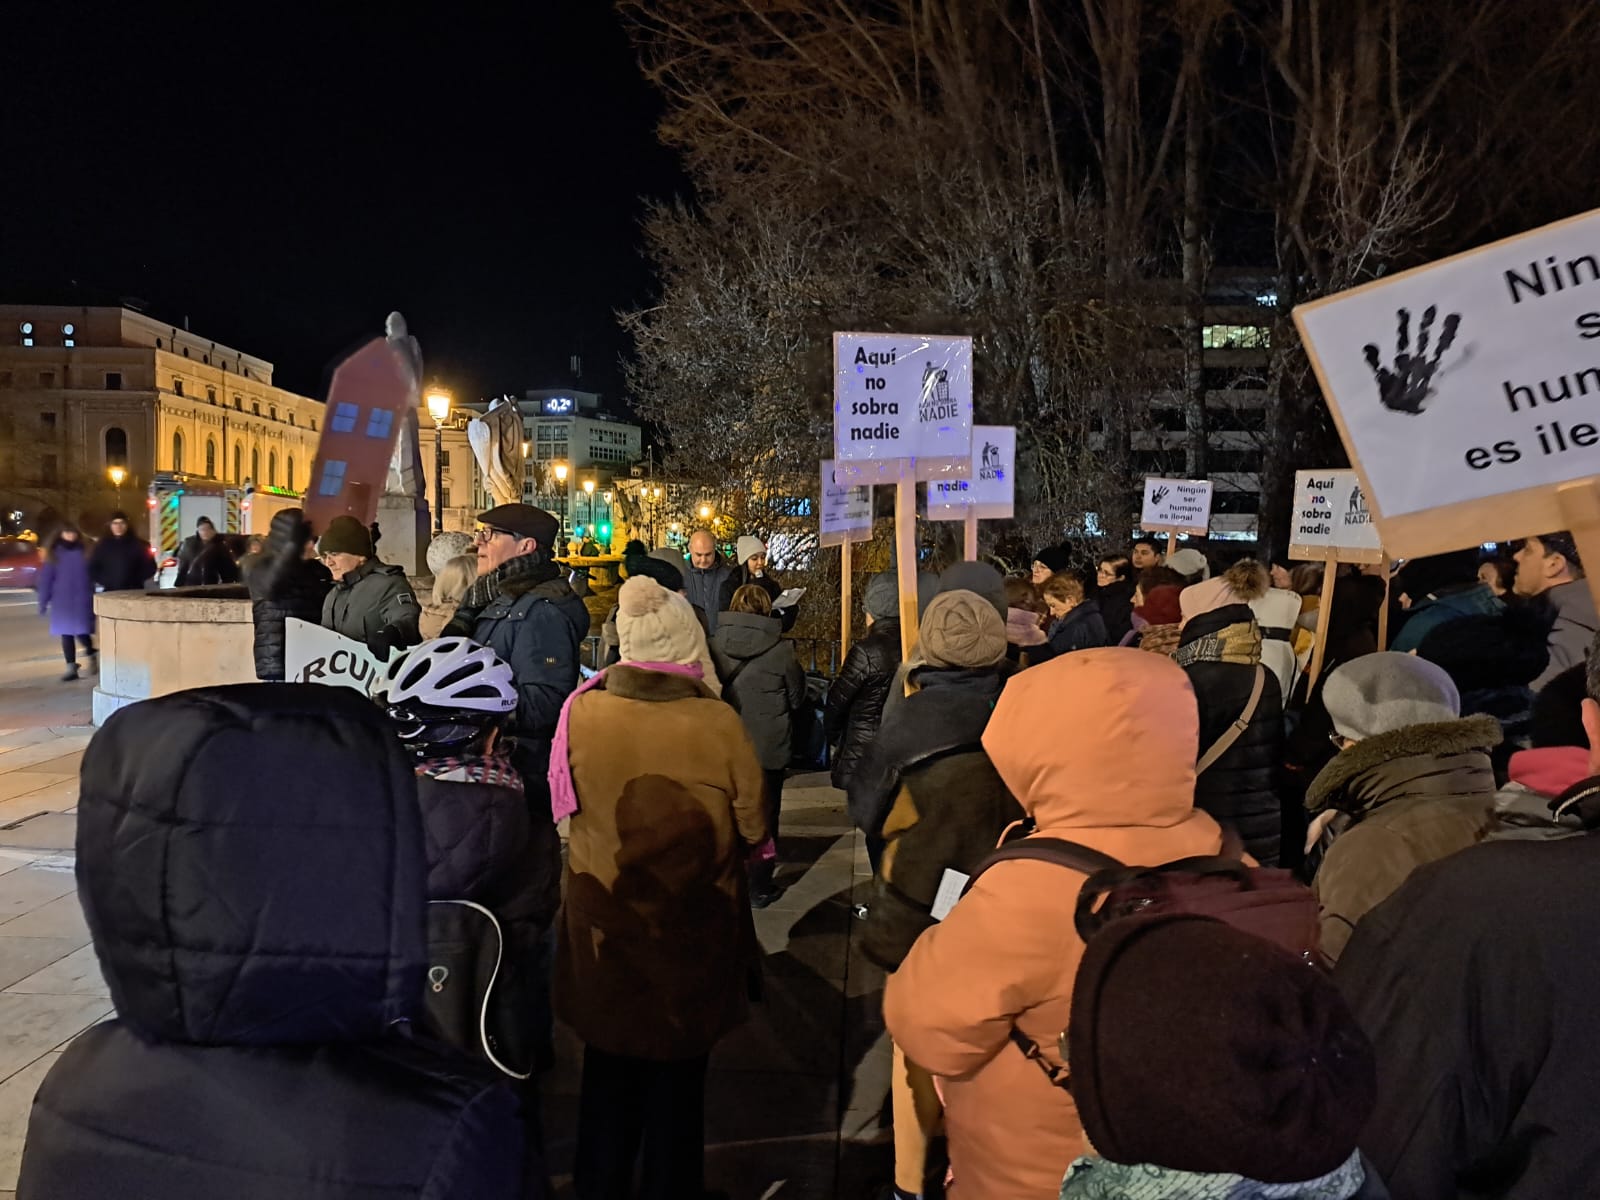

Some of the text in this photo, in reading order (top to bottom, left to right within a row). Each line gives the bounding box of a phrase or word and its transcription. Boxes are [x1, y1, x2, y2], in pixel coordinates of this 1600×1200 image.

[1504, 255, 1600, 304] Nin
[854, 346, 897, 368] Aquí
[865, 377, 886, 390] no
[851, 397, 899, 415] sobra
[919, 403, 959, 422] NADIE
[851, 422, 900, 440] nadie
[1465, 421, 1600, 470] es ile
[937, 480, 968, 492] nadie
[1177, 485, 1207, 495] Ningún
[1307, 477, 1335, 490] Aquí
[1311, 495, 1325, 504] no
[1170, 503, 1203, 513] humano
[1302, 508, 1332, 519] sobra
[1300, 523, 1331, 534] nadie
[295, 649, 377, 697] RCUL
